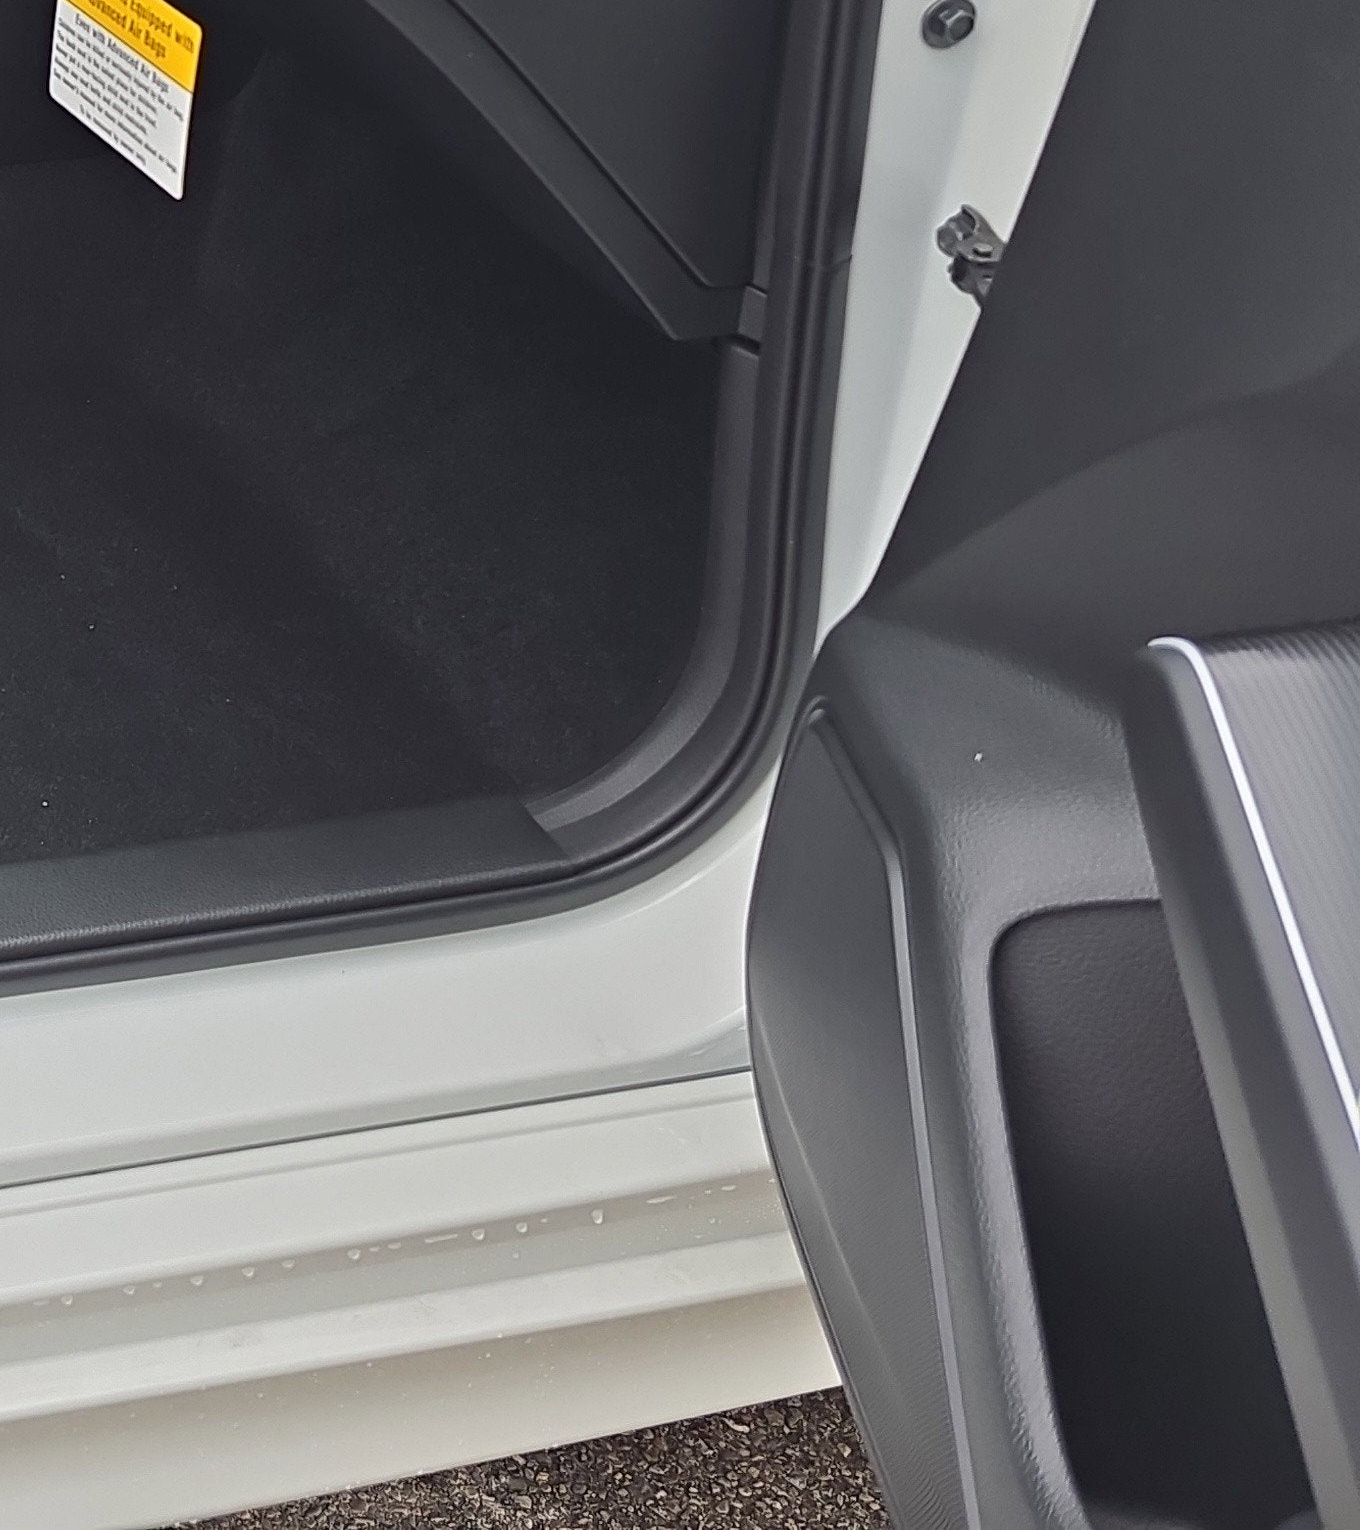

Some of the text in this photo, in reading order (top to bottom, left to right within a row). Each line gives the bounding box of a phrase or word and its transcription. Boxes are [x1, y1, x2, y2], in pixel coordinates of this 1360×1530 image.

[128, 17, 142, 40] Air
[143, 29, 167, 62] Bags
[174, 26, 194, 54] with
